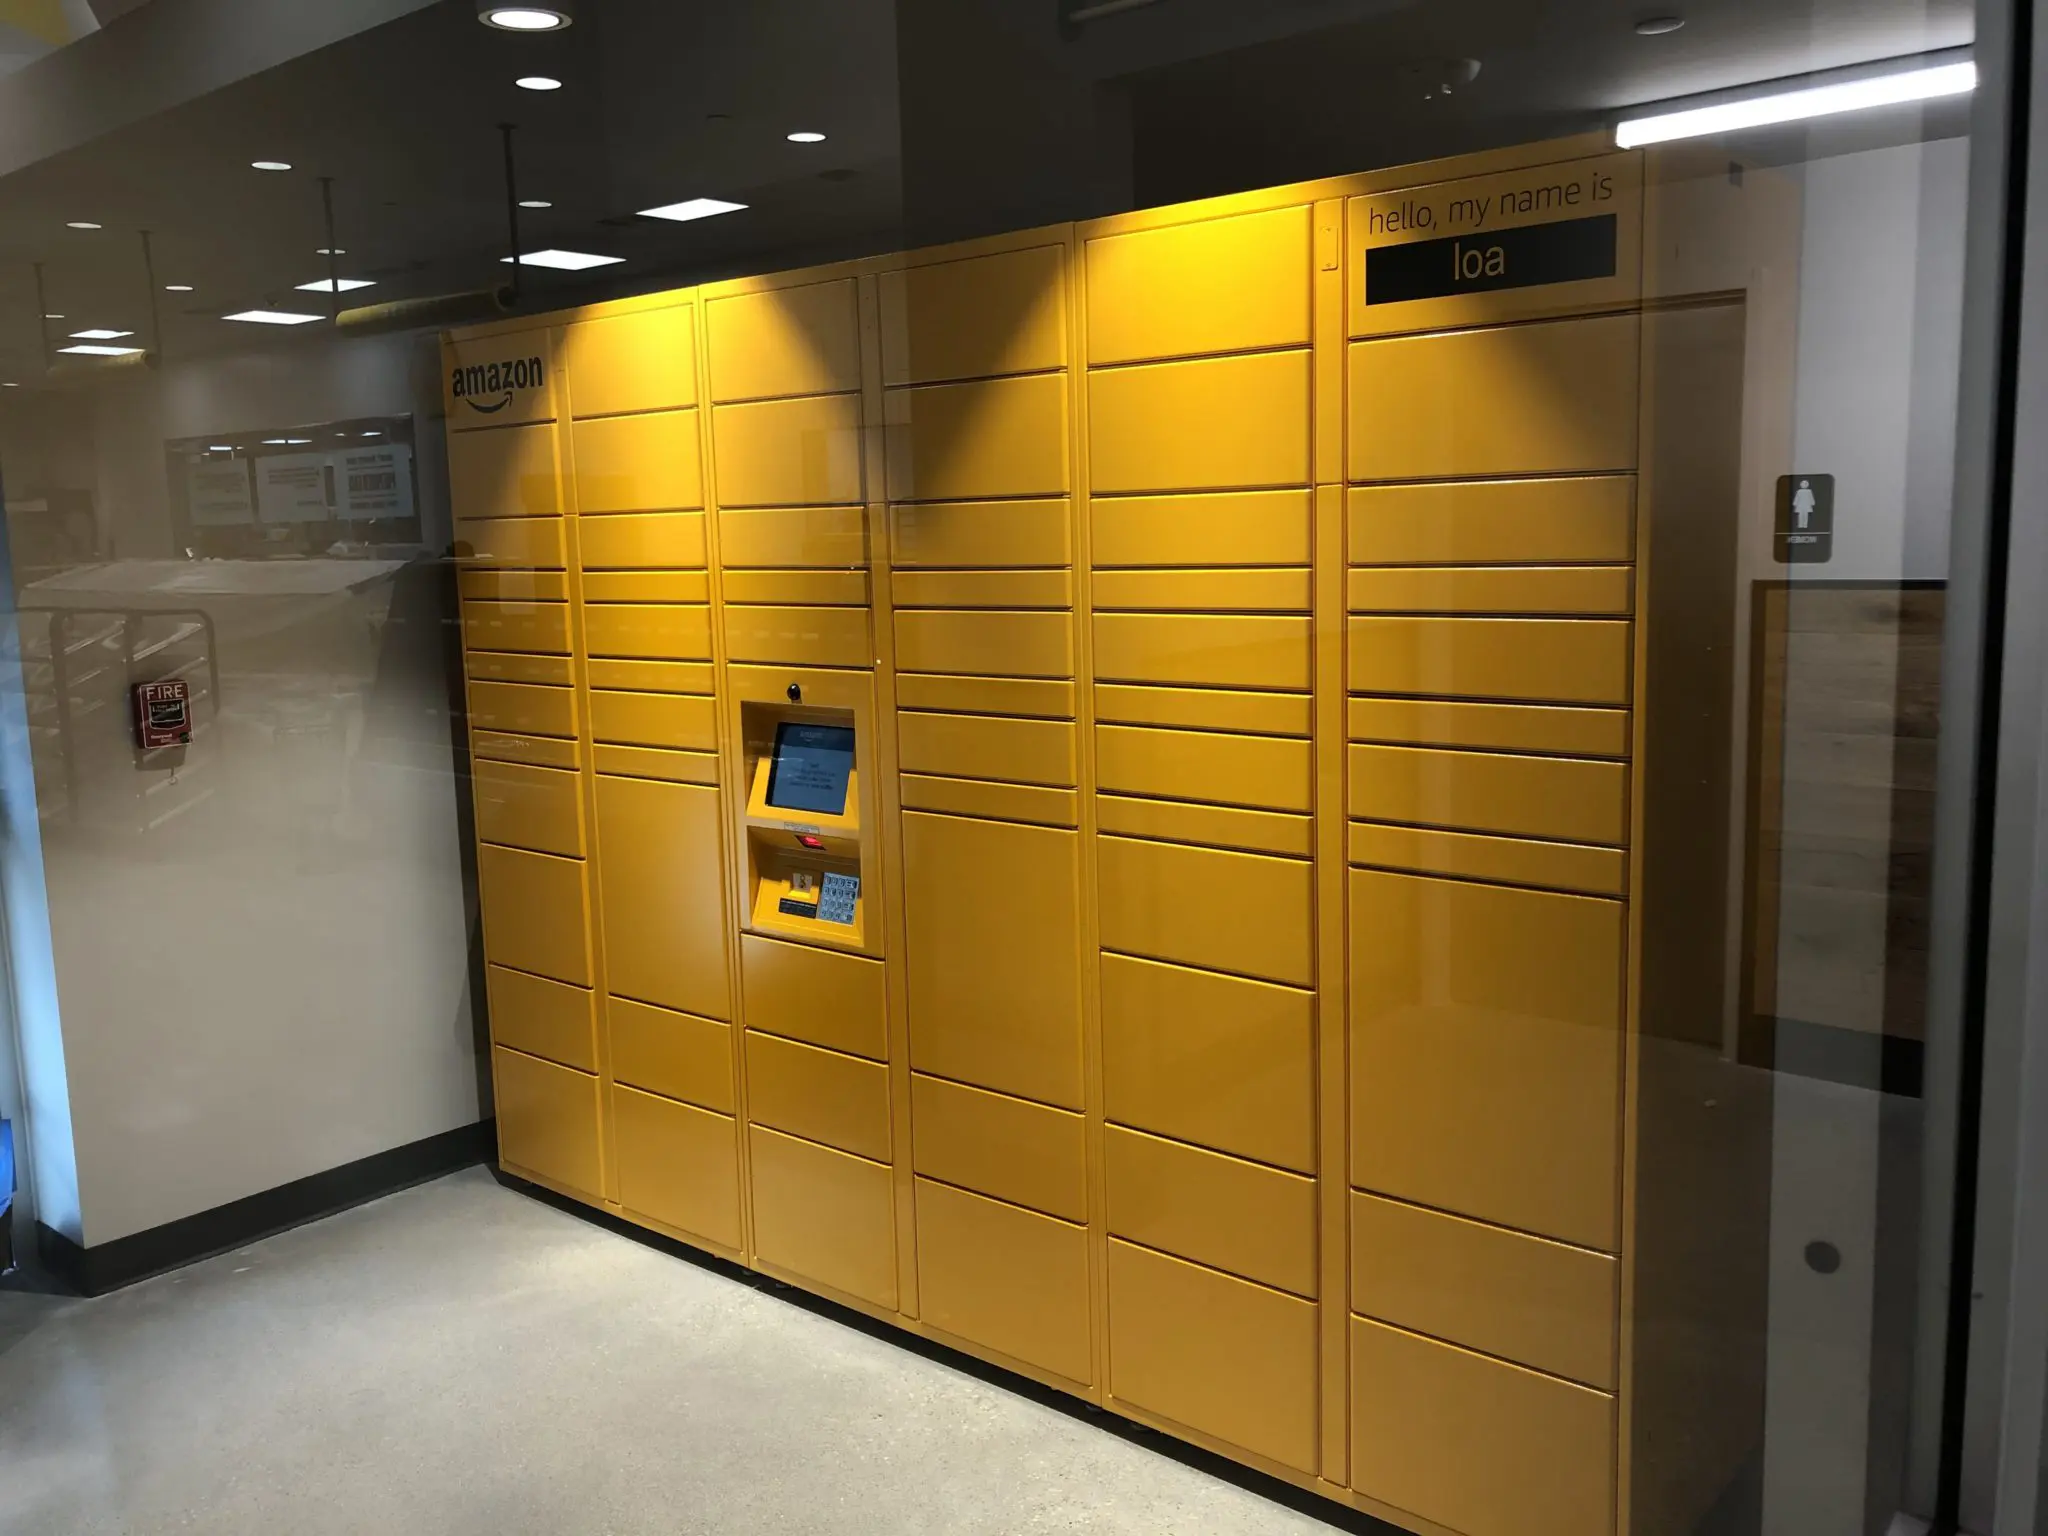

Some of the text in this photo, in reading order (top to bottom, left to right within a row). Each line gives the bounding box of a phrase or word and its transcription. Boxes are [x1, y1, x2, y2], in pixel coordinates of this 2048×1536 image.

[1369, 172, 1613, 235] hello, my name is
[1454, 241, 1505, 281] loa
[452, 356, 544, 397] amazon
[146, 684, 184, 700] FIRE
